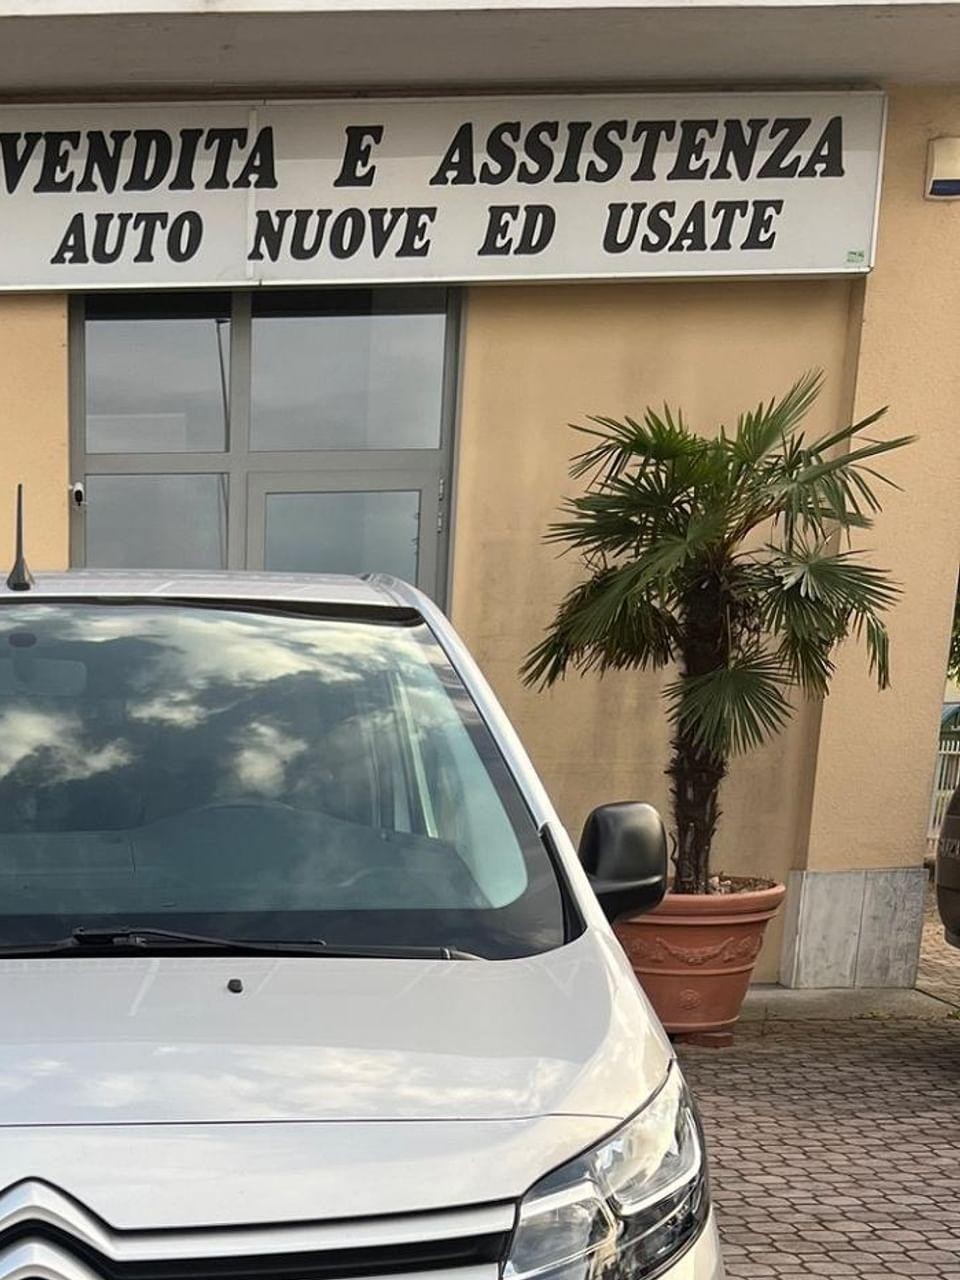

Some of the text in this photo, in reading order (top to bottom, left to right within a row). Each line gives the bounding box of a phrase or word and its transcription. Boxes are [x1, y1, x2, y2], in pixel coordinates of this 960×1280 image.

[333, 125, 385, 188] E
[430, 116, 845, 186] ASSISTENZA
[50, 200, 784, 265] AUTO NUOVE ED USATE
